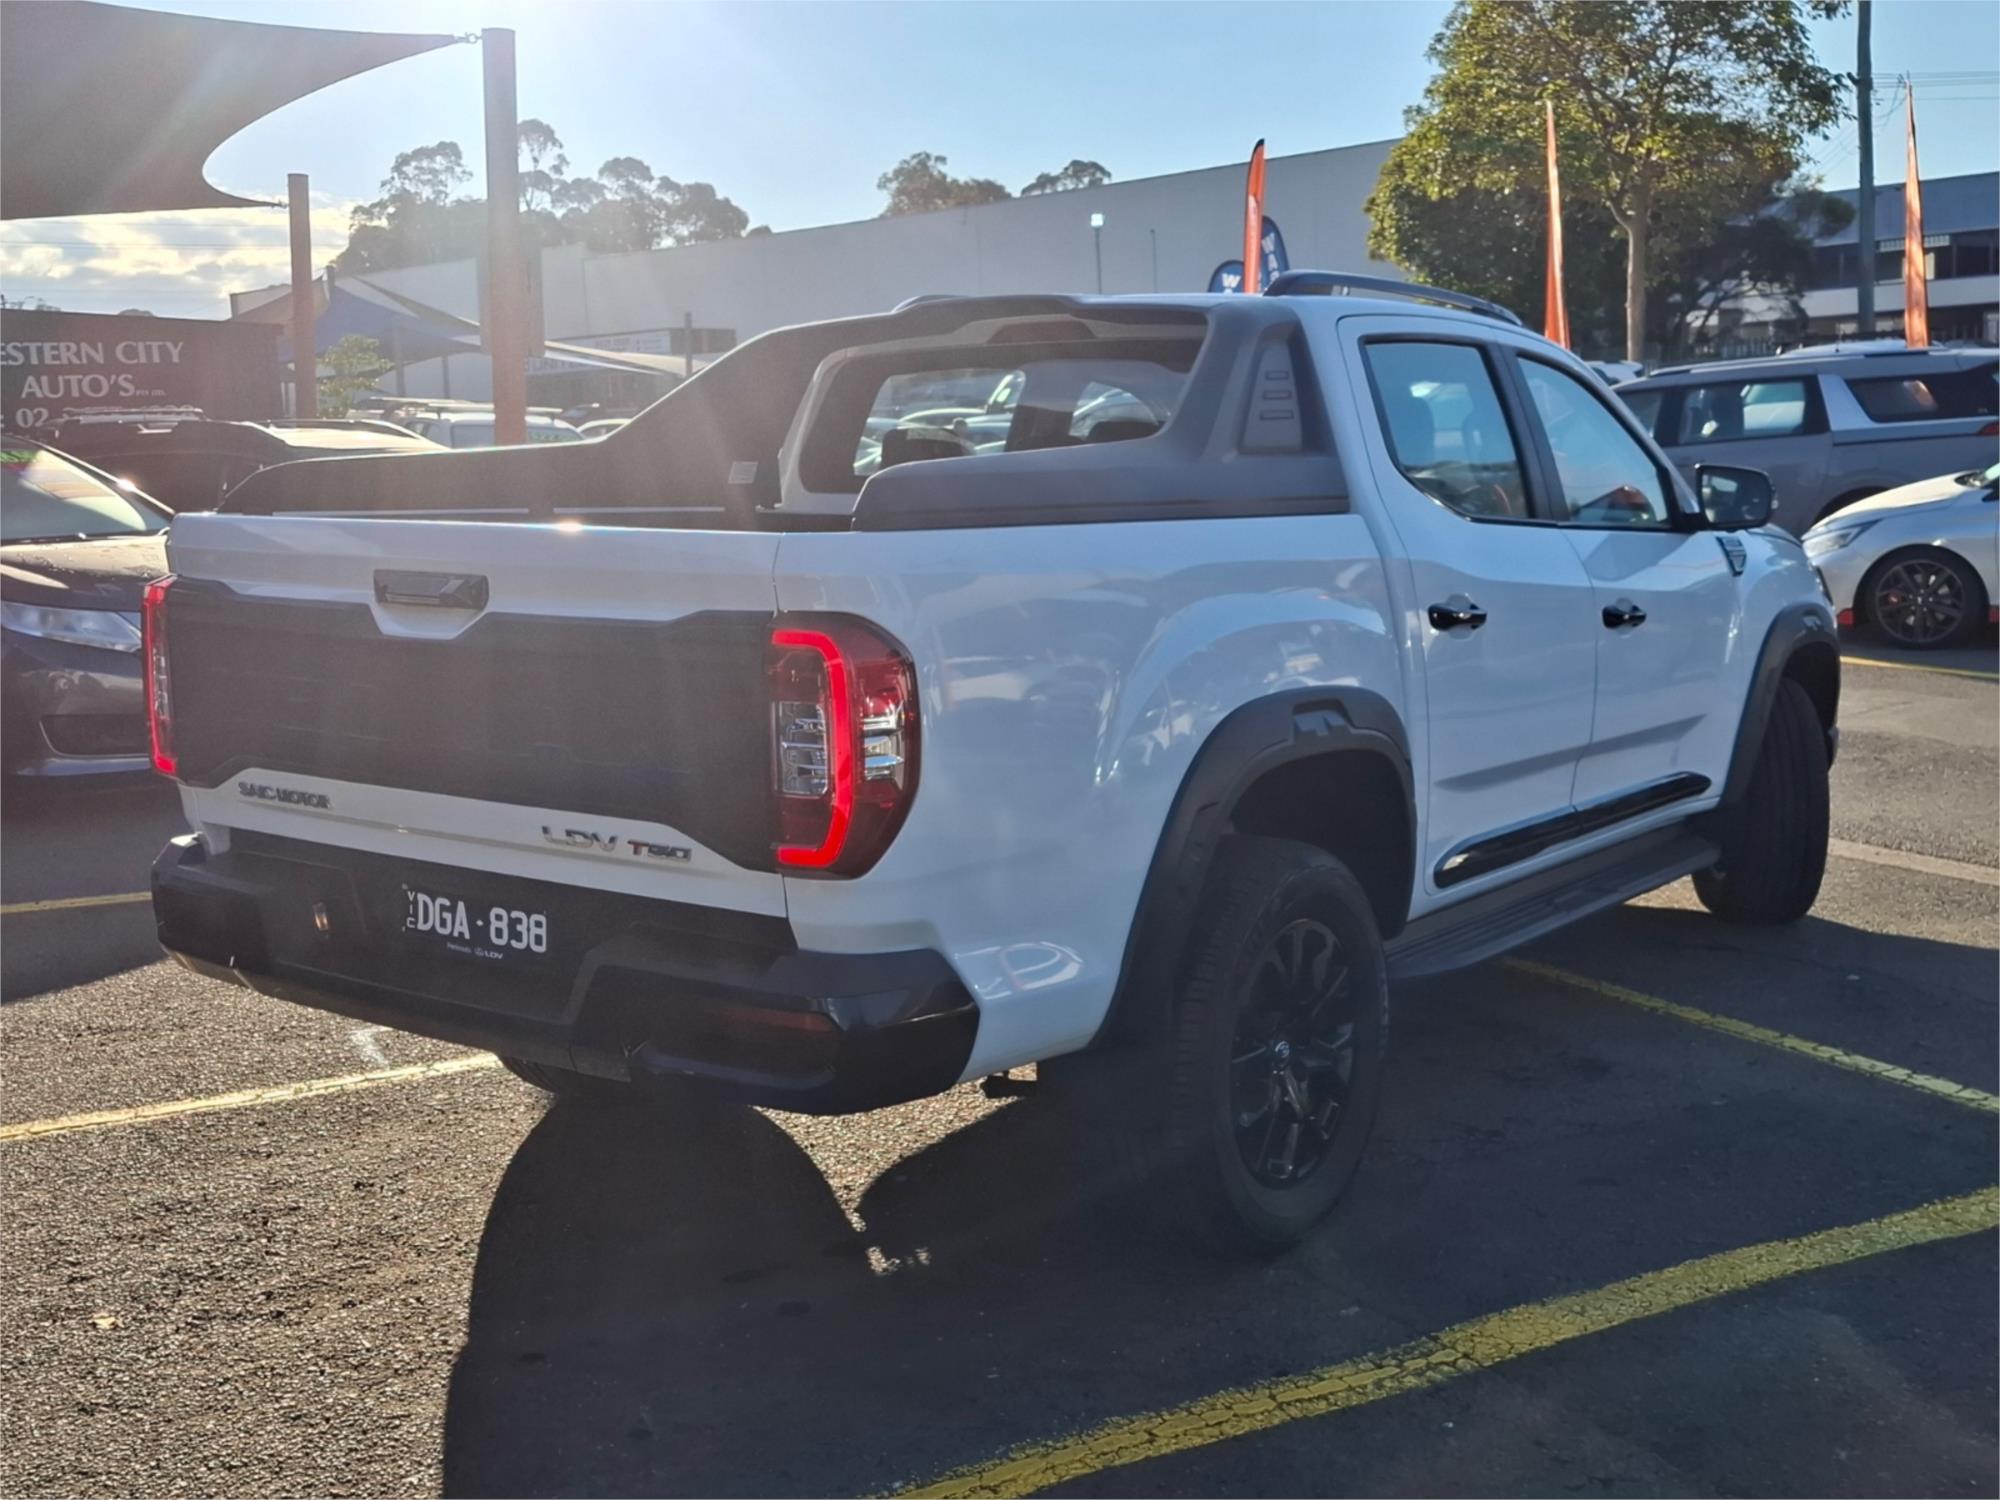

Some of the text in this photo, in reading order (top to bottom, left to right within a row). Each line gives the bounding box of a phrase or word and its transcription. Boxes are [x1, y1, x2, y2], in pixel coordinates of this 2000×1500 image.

[116, 341, 183, 364] CITY
[21, 374, 135, 399] AUTO'S
[16, 407, 49, 428] 02
[542, 825, 618, 852] LDV
